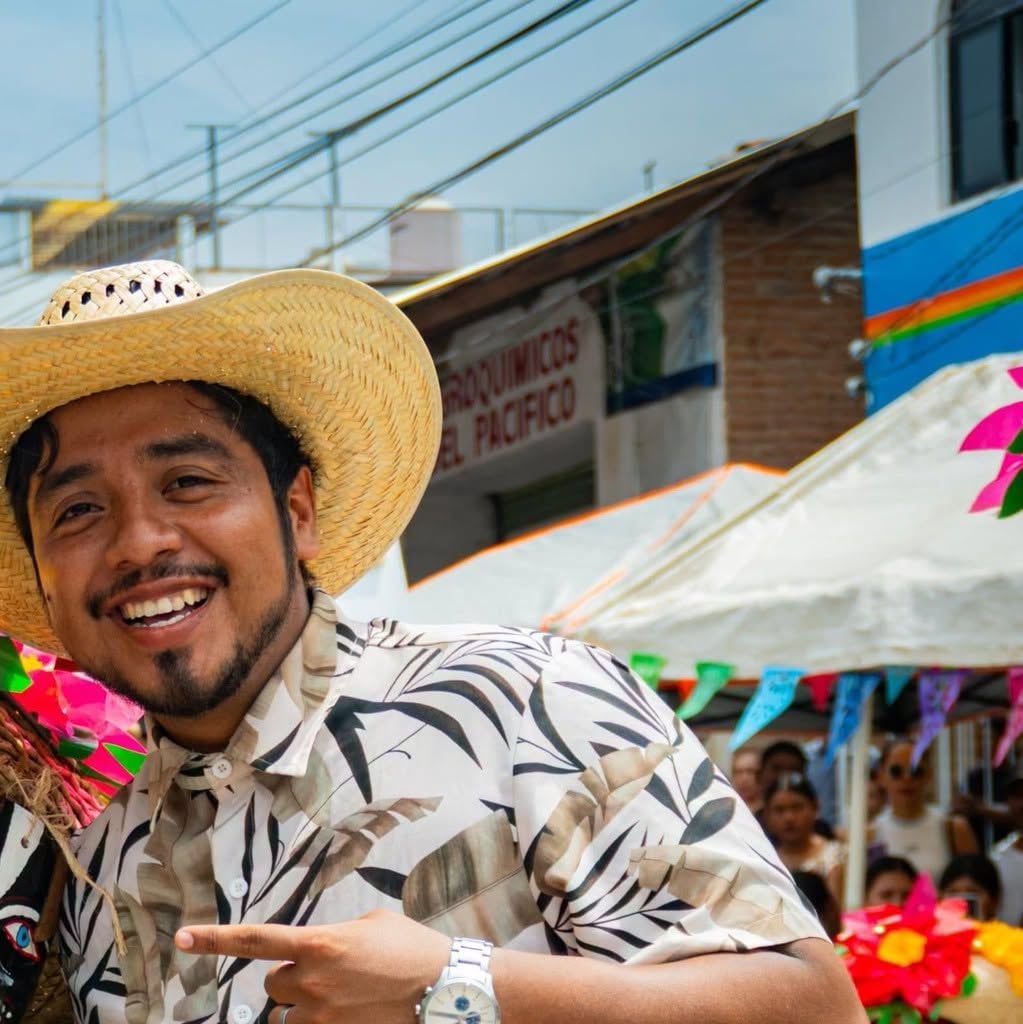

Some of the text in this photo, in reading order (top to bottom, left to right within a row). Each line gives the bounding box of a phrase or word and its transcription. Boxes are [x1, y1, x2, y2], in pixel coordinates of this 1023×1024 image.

[444, 317, 578, 414] ROQUIMICOS
[437, 377, 575, 470] EL PACIFICO
